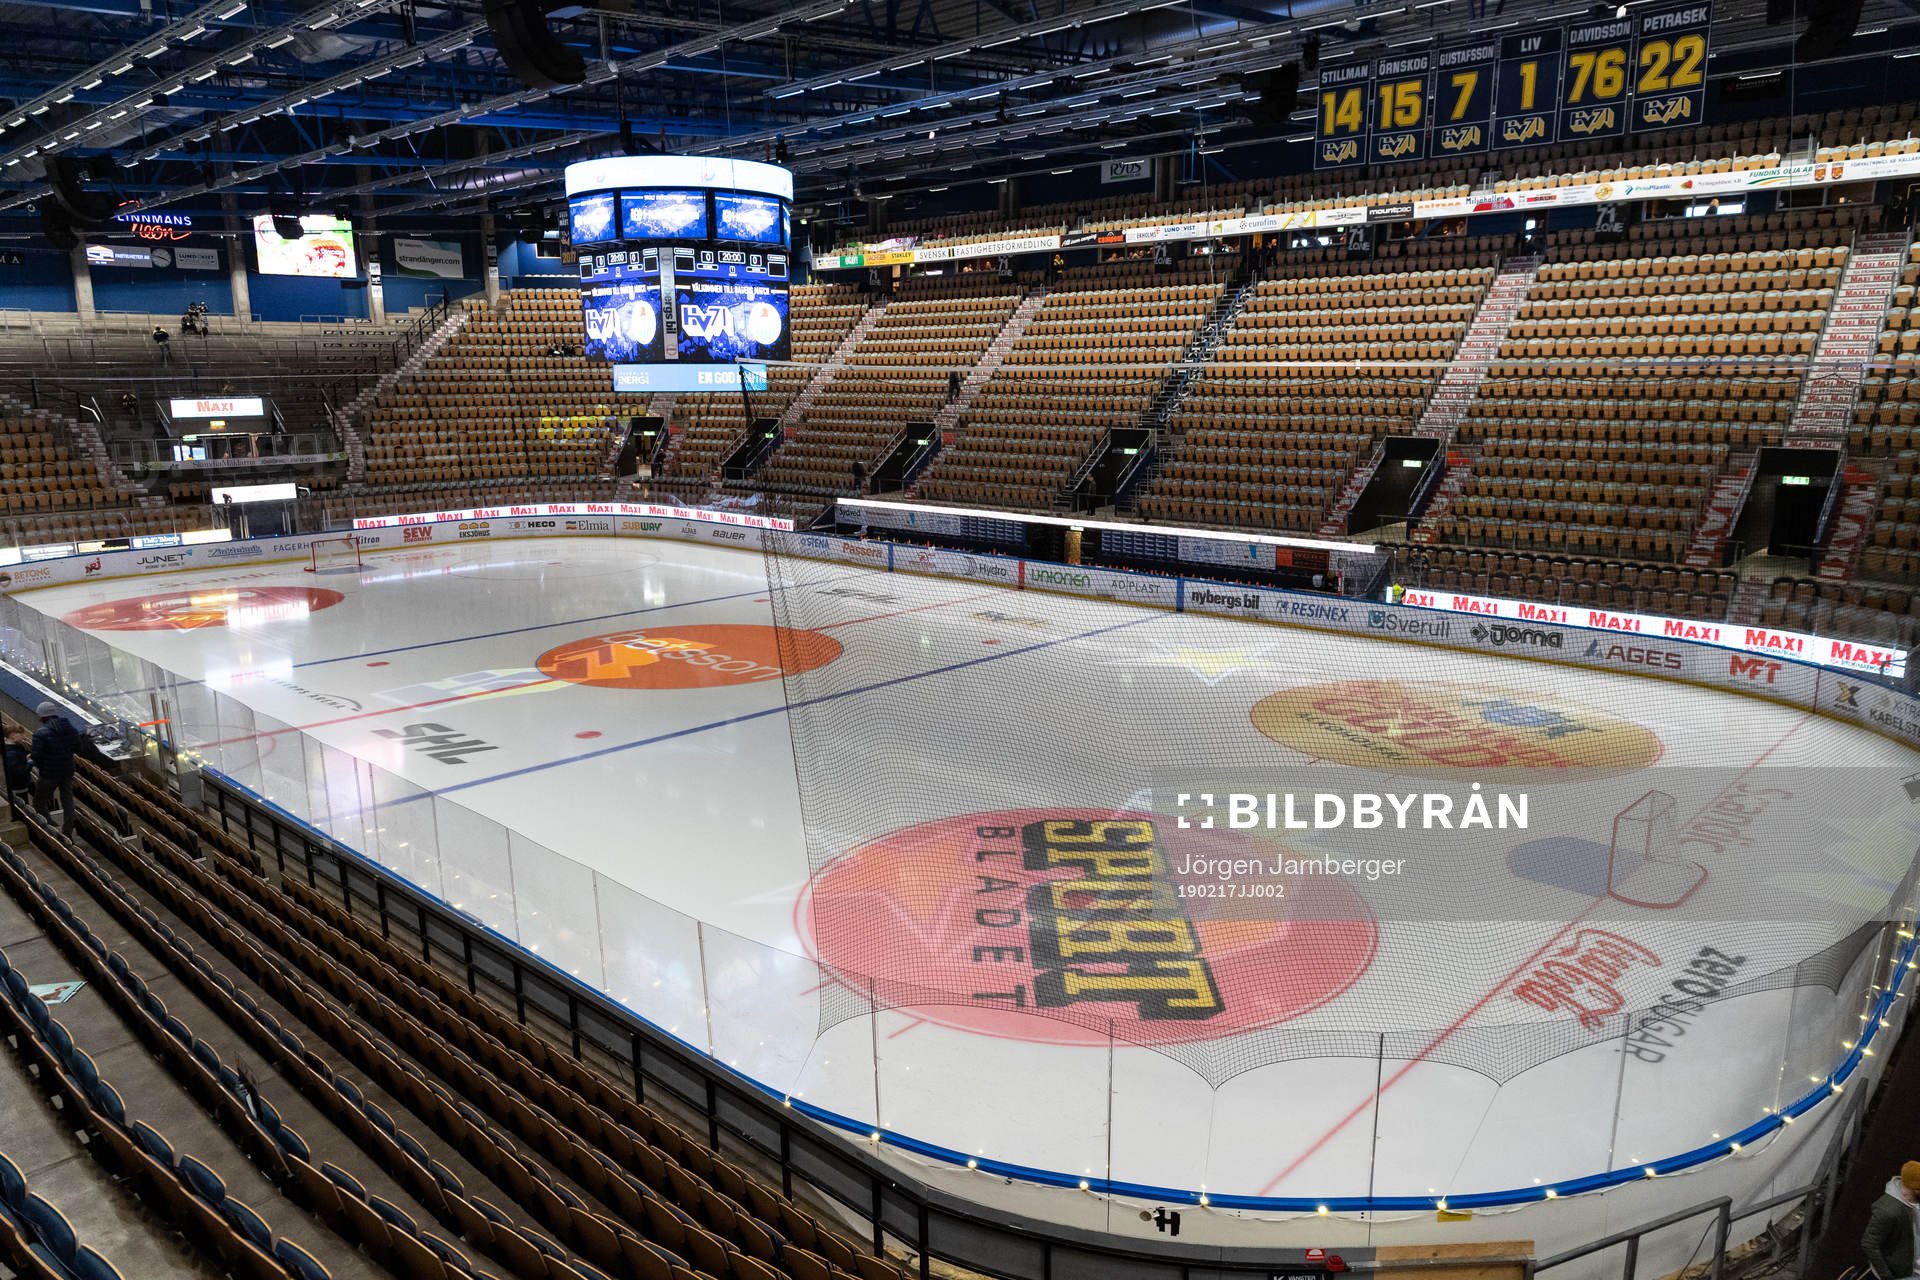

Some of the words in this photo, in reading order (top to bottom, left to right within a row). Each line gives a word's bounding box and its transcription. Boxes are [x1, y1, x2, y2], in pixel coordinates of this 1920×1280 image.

[1643, 6, 1708, 32] PETRASEK
[1569, 21, 1631, 44] DAVIDSSON
[1520, 36, 1542, 53] LIV
[1378, 56, 1428, 76] ÖRNSKOG
[1439, 45, 1494, 66] GUSTAFSSON
[1637, 33, 1706, 94] 22
[1321, 64, 1369, 84] STILLMAN
[1567, 47, 1627, 104] 76
[1451, 71, 1479, 121] 7
[1519, 61, 1538, 110] 1
[1322, 87, 1363, 136] 14
[1379, 80, 1423, 130] 15
[1749, 168, 1781, 178] FUNDINS
[1782, 167, 1801, 176] OLJA
[1802, 165, 1814, 174] AB
[117, 214, 192, 226] LINNMANS
[1368, 206, 1412, 216] mountpac
[398, 253, 461, 266] strandängen.com
[722, 252, 742, 262] 20:00
[919, 249, 946, 260] SVENSK
[956, 238, 1053, 257] FASTIGHETSFÖRMEDLING
[680, 303, 735, 343] HV71
[196, 400, 234, 413] MAXI
[357, 518, 387, 529] MAXI
[398, 515, 426, 526] MAXI
[436, 512, 463, 523] MAXI
[473, 508, 500, 519] MAXI
[510, 506, 538, 516] MAXI
[548, 504, 576, 514] MAXI
[587, 503, 614, 513] MAXI
[620, 503, 641, 514] MAXI
[649, 505, 668, 516] MAXI
[673, 507, 691, 518] MAXI
[696, 510, 713, 520] MAXI
[719, 512, 738, 524] MAXI
[527, 519, 556, 529] HECO
[577, 519, 609, 531] Elmia
[621, 521, 663, 532] SUBWAY
[402, 525, 432, 539] SEW
[136, 553, 187, 566] JUNET
[842, 541, 883, 558] Passera
[14, 566, 51, 580] BETONG
[84, 557, 102, 574] NRJ
[978, 562, 1007, 577] Hydro
[1191, 589, 1242, 609] nybergs
[1243, 593, 1260, 610] bil
[1290, 601, 1350, 622] RESINEX
[1386, 612, 1451, 638] Sverull
[1402, 593, 1435, 608] AXI
[1452, 596, 1498, 615] MAXI
[1518, 603, 1567, 623] MAXI
[1588, 611, 1641, 633] MAXI
[1664, 619, 1720, 642] MAXI
[1745, 629, 1804, 653] MAXI
[1831, 640, 1893, 668] MAXI
[600, 629, 785, 680] betsson
[1604, 644, 1682, 670] AGES
[401, 722, 500, 766] SHL
[972, 825, 1027, 1009] BLADET
[1030, 820, 1224, 1019] SPORT
